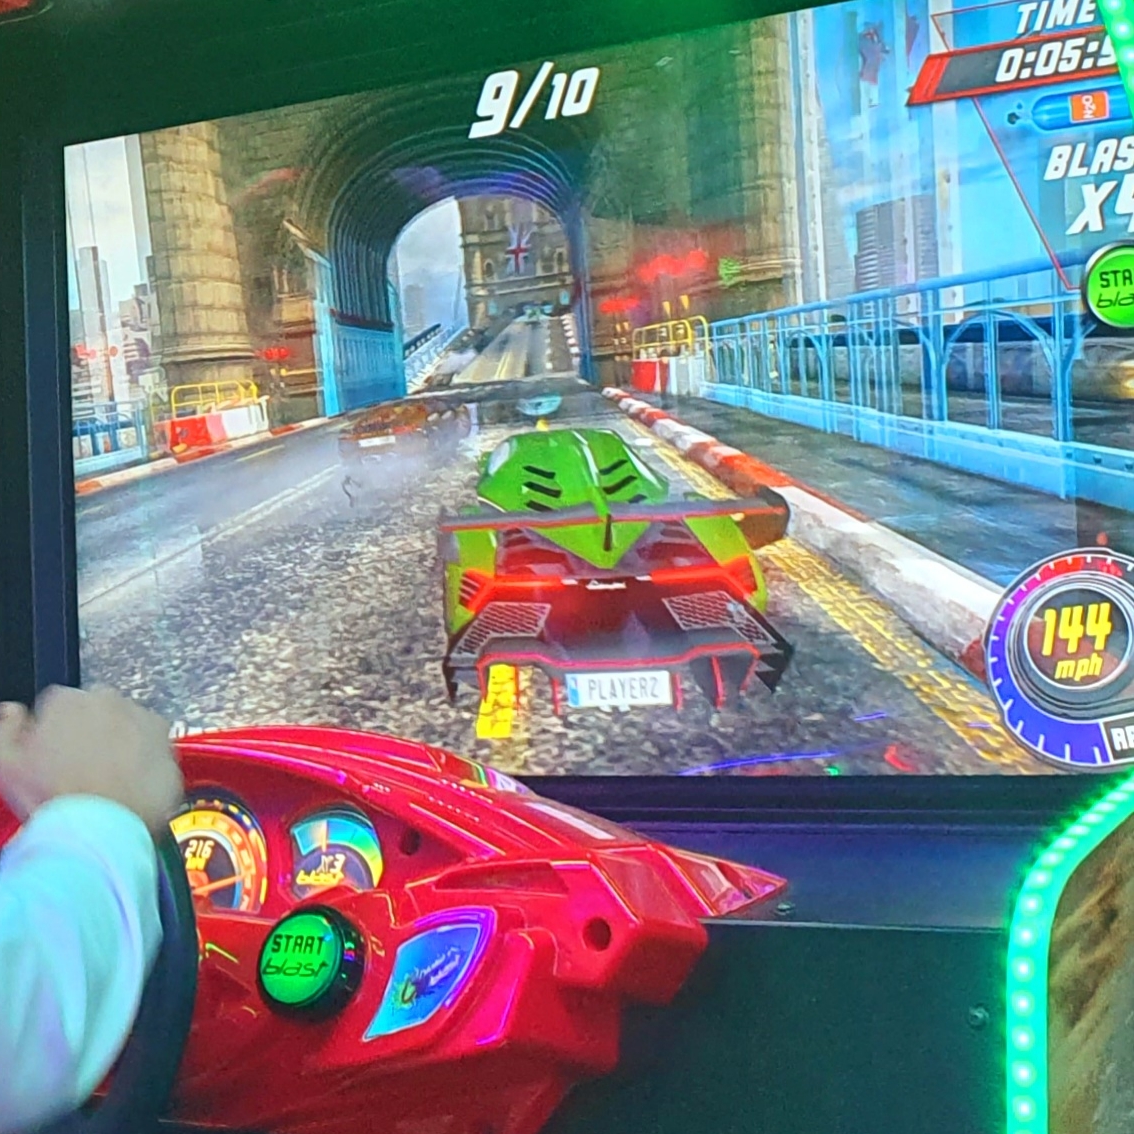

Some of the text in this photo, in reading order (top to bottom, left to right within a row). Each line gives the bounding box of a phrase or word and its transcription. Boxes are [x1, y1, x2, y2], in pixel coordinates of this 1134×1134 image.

[1016, 0, 1097, 35] TIME
[468, 60, 600, 139] 9/10
[1042, 602, 1112, 657] 144
[1054, 652, 1104, 682] mph
